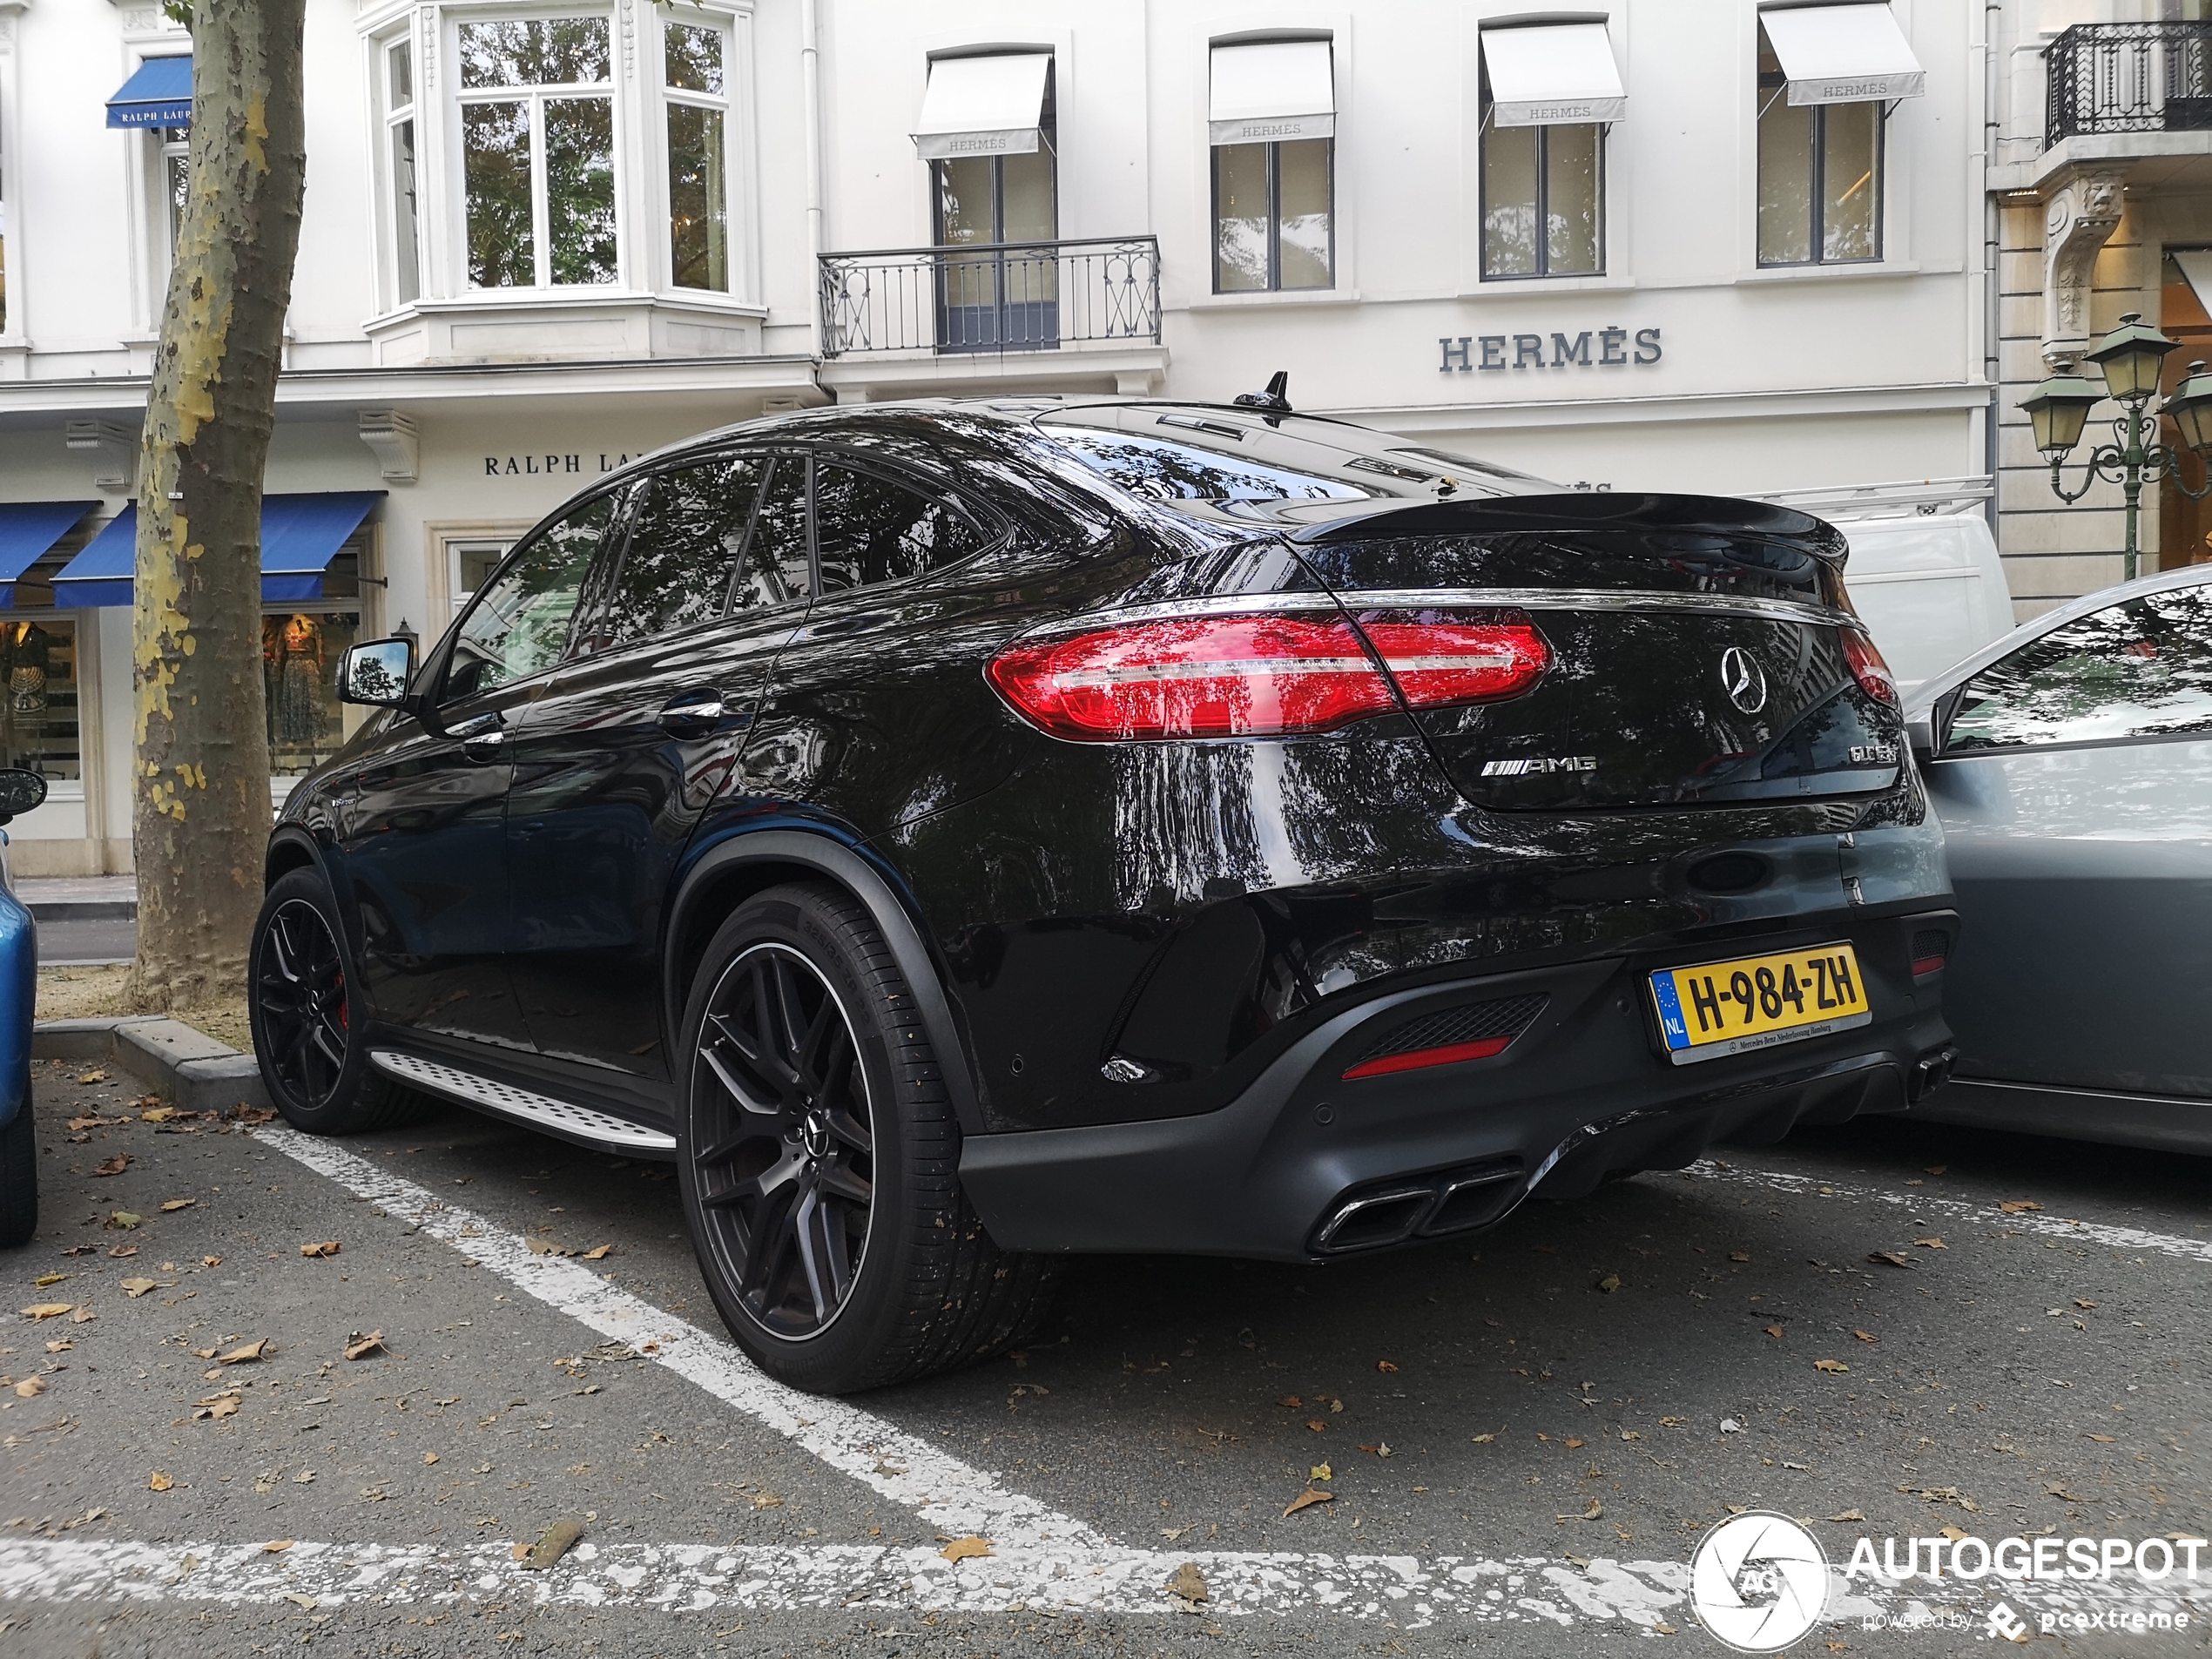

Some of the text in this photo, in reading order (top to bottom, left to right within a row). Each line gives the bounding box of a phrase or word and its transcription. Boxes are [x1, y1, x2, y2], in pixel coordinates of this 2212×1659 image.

[122, 111, 157, 122] RALPH
[484, 455, 580, 475] RALPH
[1520, 756, 1596, 775] AMG
[1689, 955, 1858, 1032] H-984-ZH
[1665, 1017, 1685, 1036] NL
[1739, 1035, 1777, 1050] Mercedes-Benz
[1810, 1024, 1831, 1037] Hamburg
